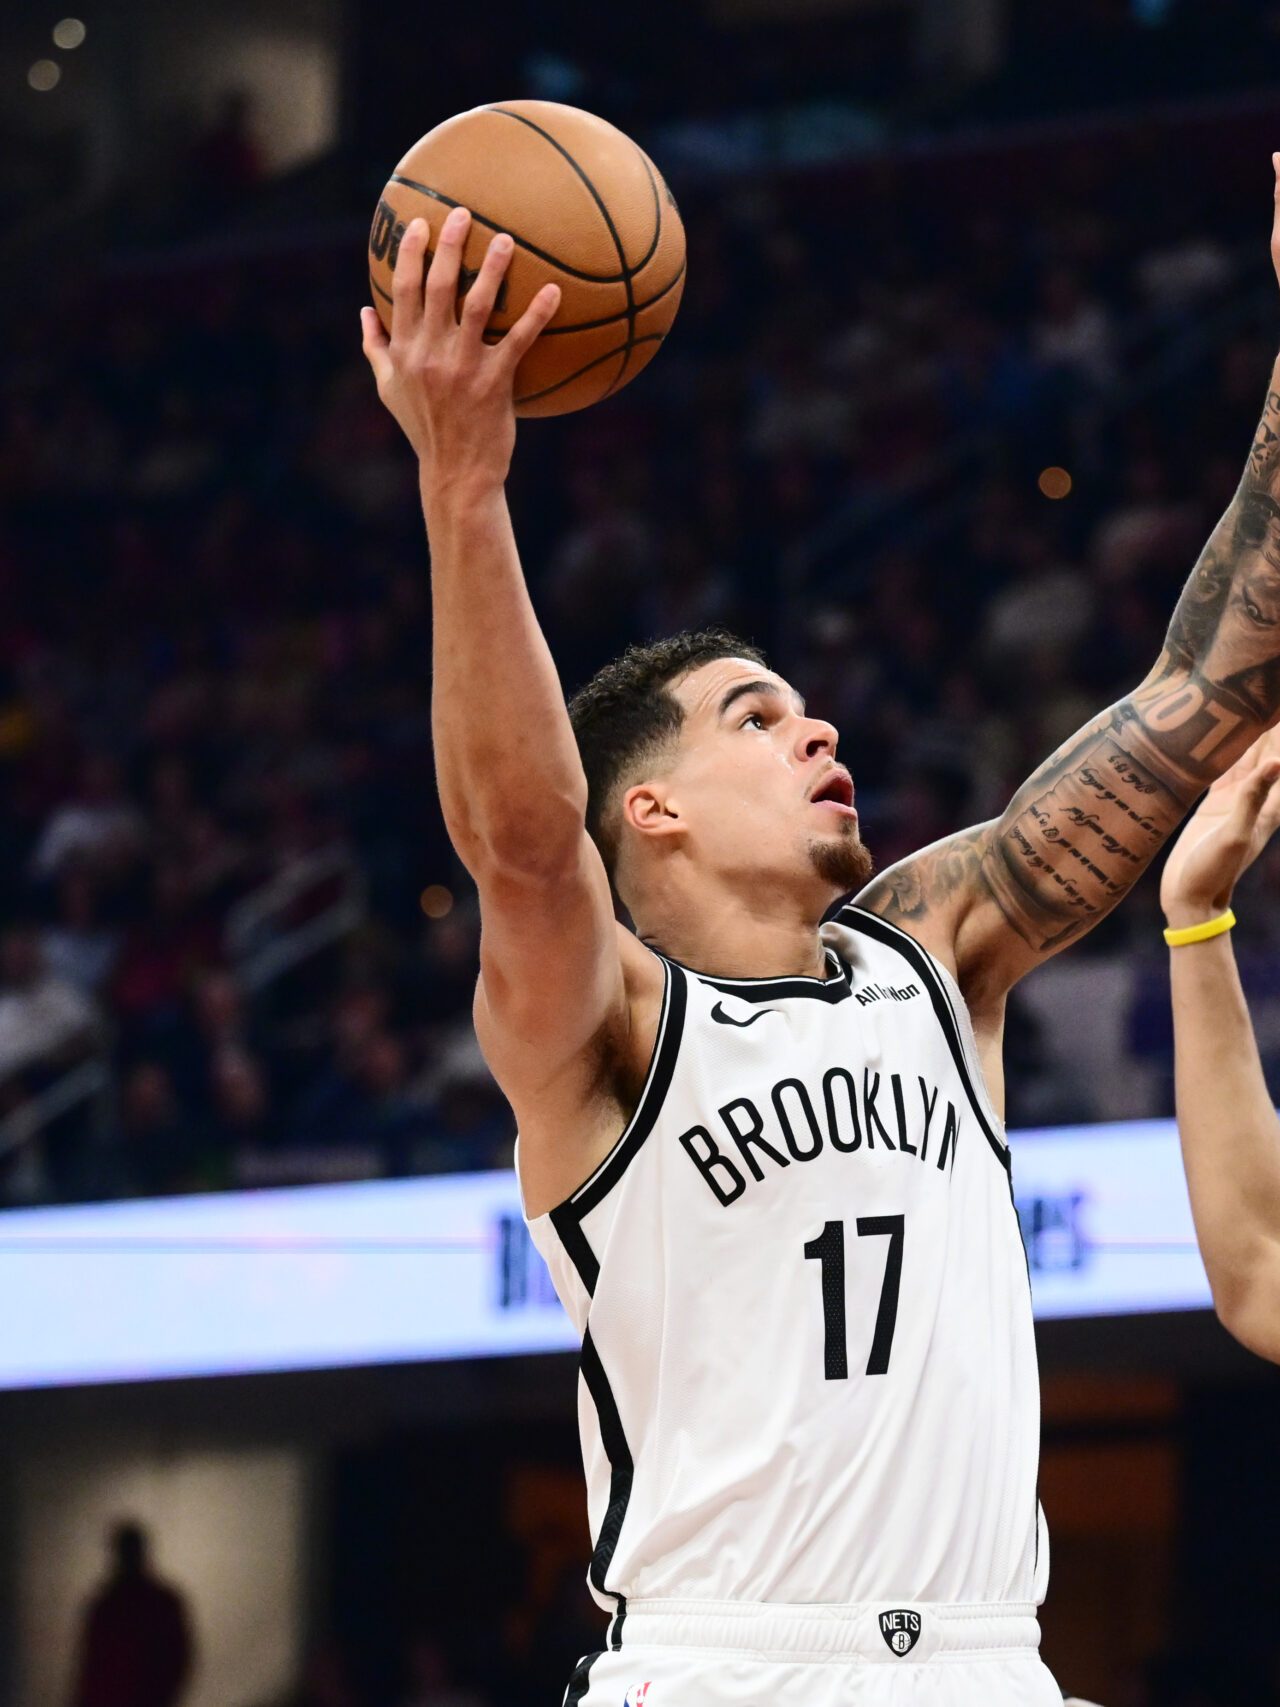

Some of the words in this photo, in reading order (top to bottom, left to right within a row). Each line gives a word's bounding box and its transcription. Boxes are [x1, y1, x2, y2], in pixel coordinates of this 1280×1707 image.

[854, 986, 881, 1006] All
[679, 1067, 960, 1207] BROOKLYN
[804, 1214, 905, 1380] 17
[882, 1612, 919, 1632] NETS
